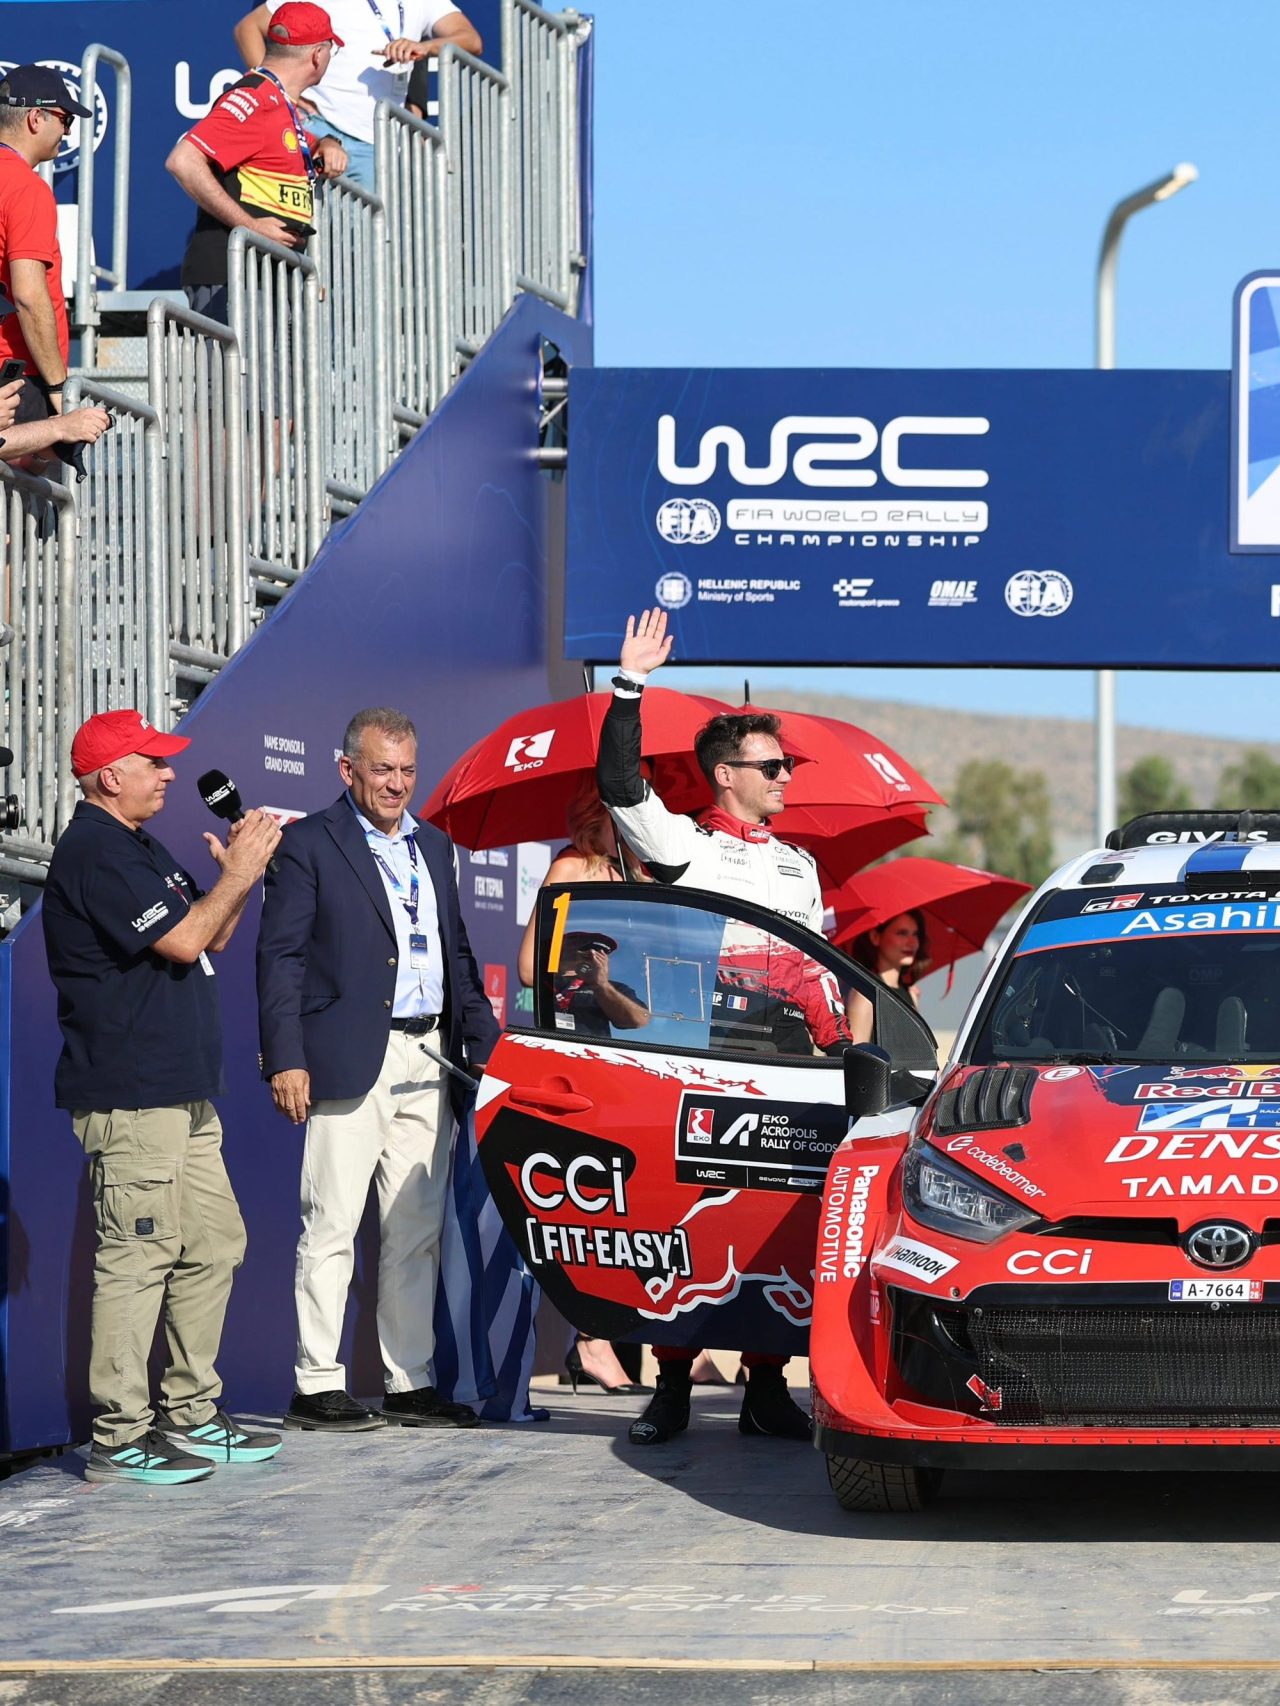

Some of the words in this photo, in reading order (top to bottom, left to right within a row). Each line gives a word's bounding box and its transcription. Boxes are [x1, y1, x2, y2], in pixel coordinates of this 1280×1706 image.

[658, 414, 990, 488] WRC
[736, 509, 774, 521] FIA
[783, 510, 878, 522] WORLD
[887, 511, 979, 523] RALLY
[735, 534, 980, 547] CHAMPIONSHIP
[698, 579, 748, 590] HELLENIC
[749, 579, 801, 591] REPUBLIC
[698, 591, 733, 603] Ministry
[734, 591, 744, 602] of
[745, 591, 775, 603] Sports
[264, 734, 279, 750] NAME
[279, 737, 301, 755] SPONSOR
[264, 755, 282, 772] GRAND
[282, 759, 305, 776] SPONSOR
[513, 759, 544, 773] EKO
[1149, 891, 1266, 905] TOYOTA
[547, 892, 570, 974] 1
[1134, 1082, 1244, 1099] Red
[761, 1114, 790, 1125] EKO
[1246, 1114, 1258, 1127] 1
[760, 1126, 818, 1139] ACROPOLIS
[760, 1138, 791, 1150] RALLY
[792, 1140, 807, 1151] OF
[808, 1141, 838, 1153] GODS
[696, 1169, 726, 1180] WRC
[819, 1166, 851, 1283] AUTOMOTIVE
[843, 1165, 880, 1279] Panasonic
[1188, 1283, 1244, 1297] A-7664
[396, 1593, 828, 1603] ACROPOLIS
[377, 1602, 604, 1612] RALLY
[628, 1603, 734, 1613] OF
[750, 1603, 970, 1615] GODS
